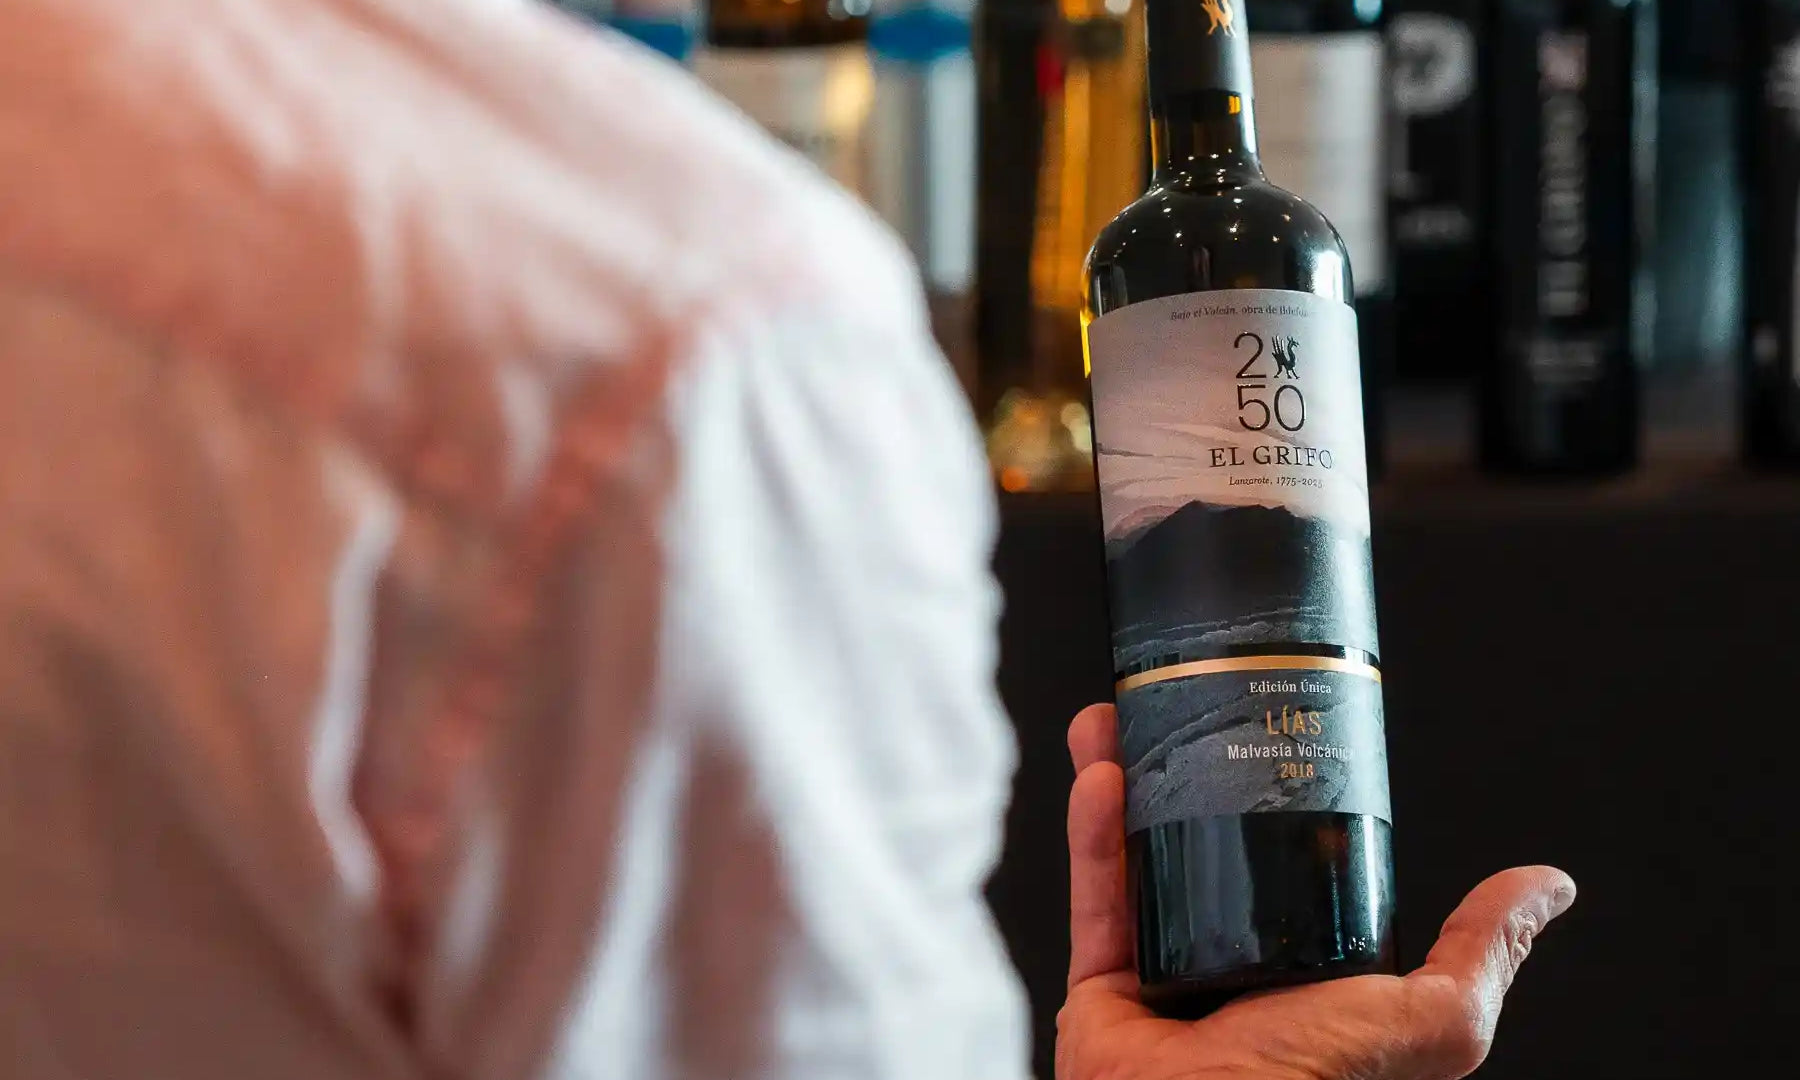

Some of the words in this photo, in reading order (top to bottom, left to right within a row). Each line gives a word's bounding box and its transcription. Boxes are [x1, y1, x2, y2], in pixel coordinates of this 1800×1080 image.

[1241, 305, 1264, 315] obra
[1265, 305, 1278, 315] de
[1233, 331, 1267, 379] 2
[1236, 384, 1307, 432] 50
[1208, 446, 1245, 468] EL
[1252, 445, 1333, 469] GRIFO
[1229, 475, 1273, 487] Lanzarote,
[1249, 680, 1297, 694] Edición
[1300, 678, 1332, 694] Única
[1265, 704, 1322, 735] LÍAS
[1227, 742, 1292, 760] Malvasía
[1280, 762, 1315, 778] 2018
